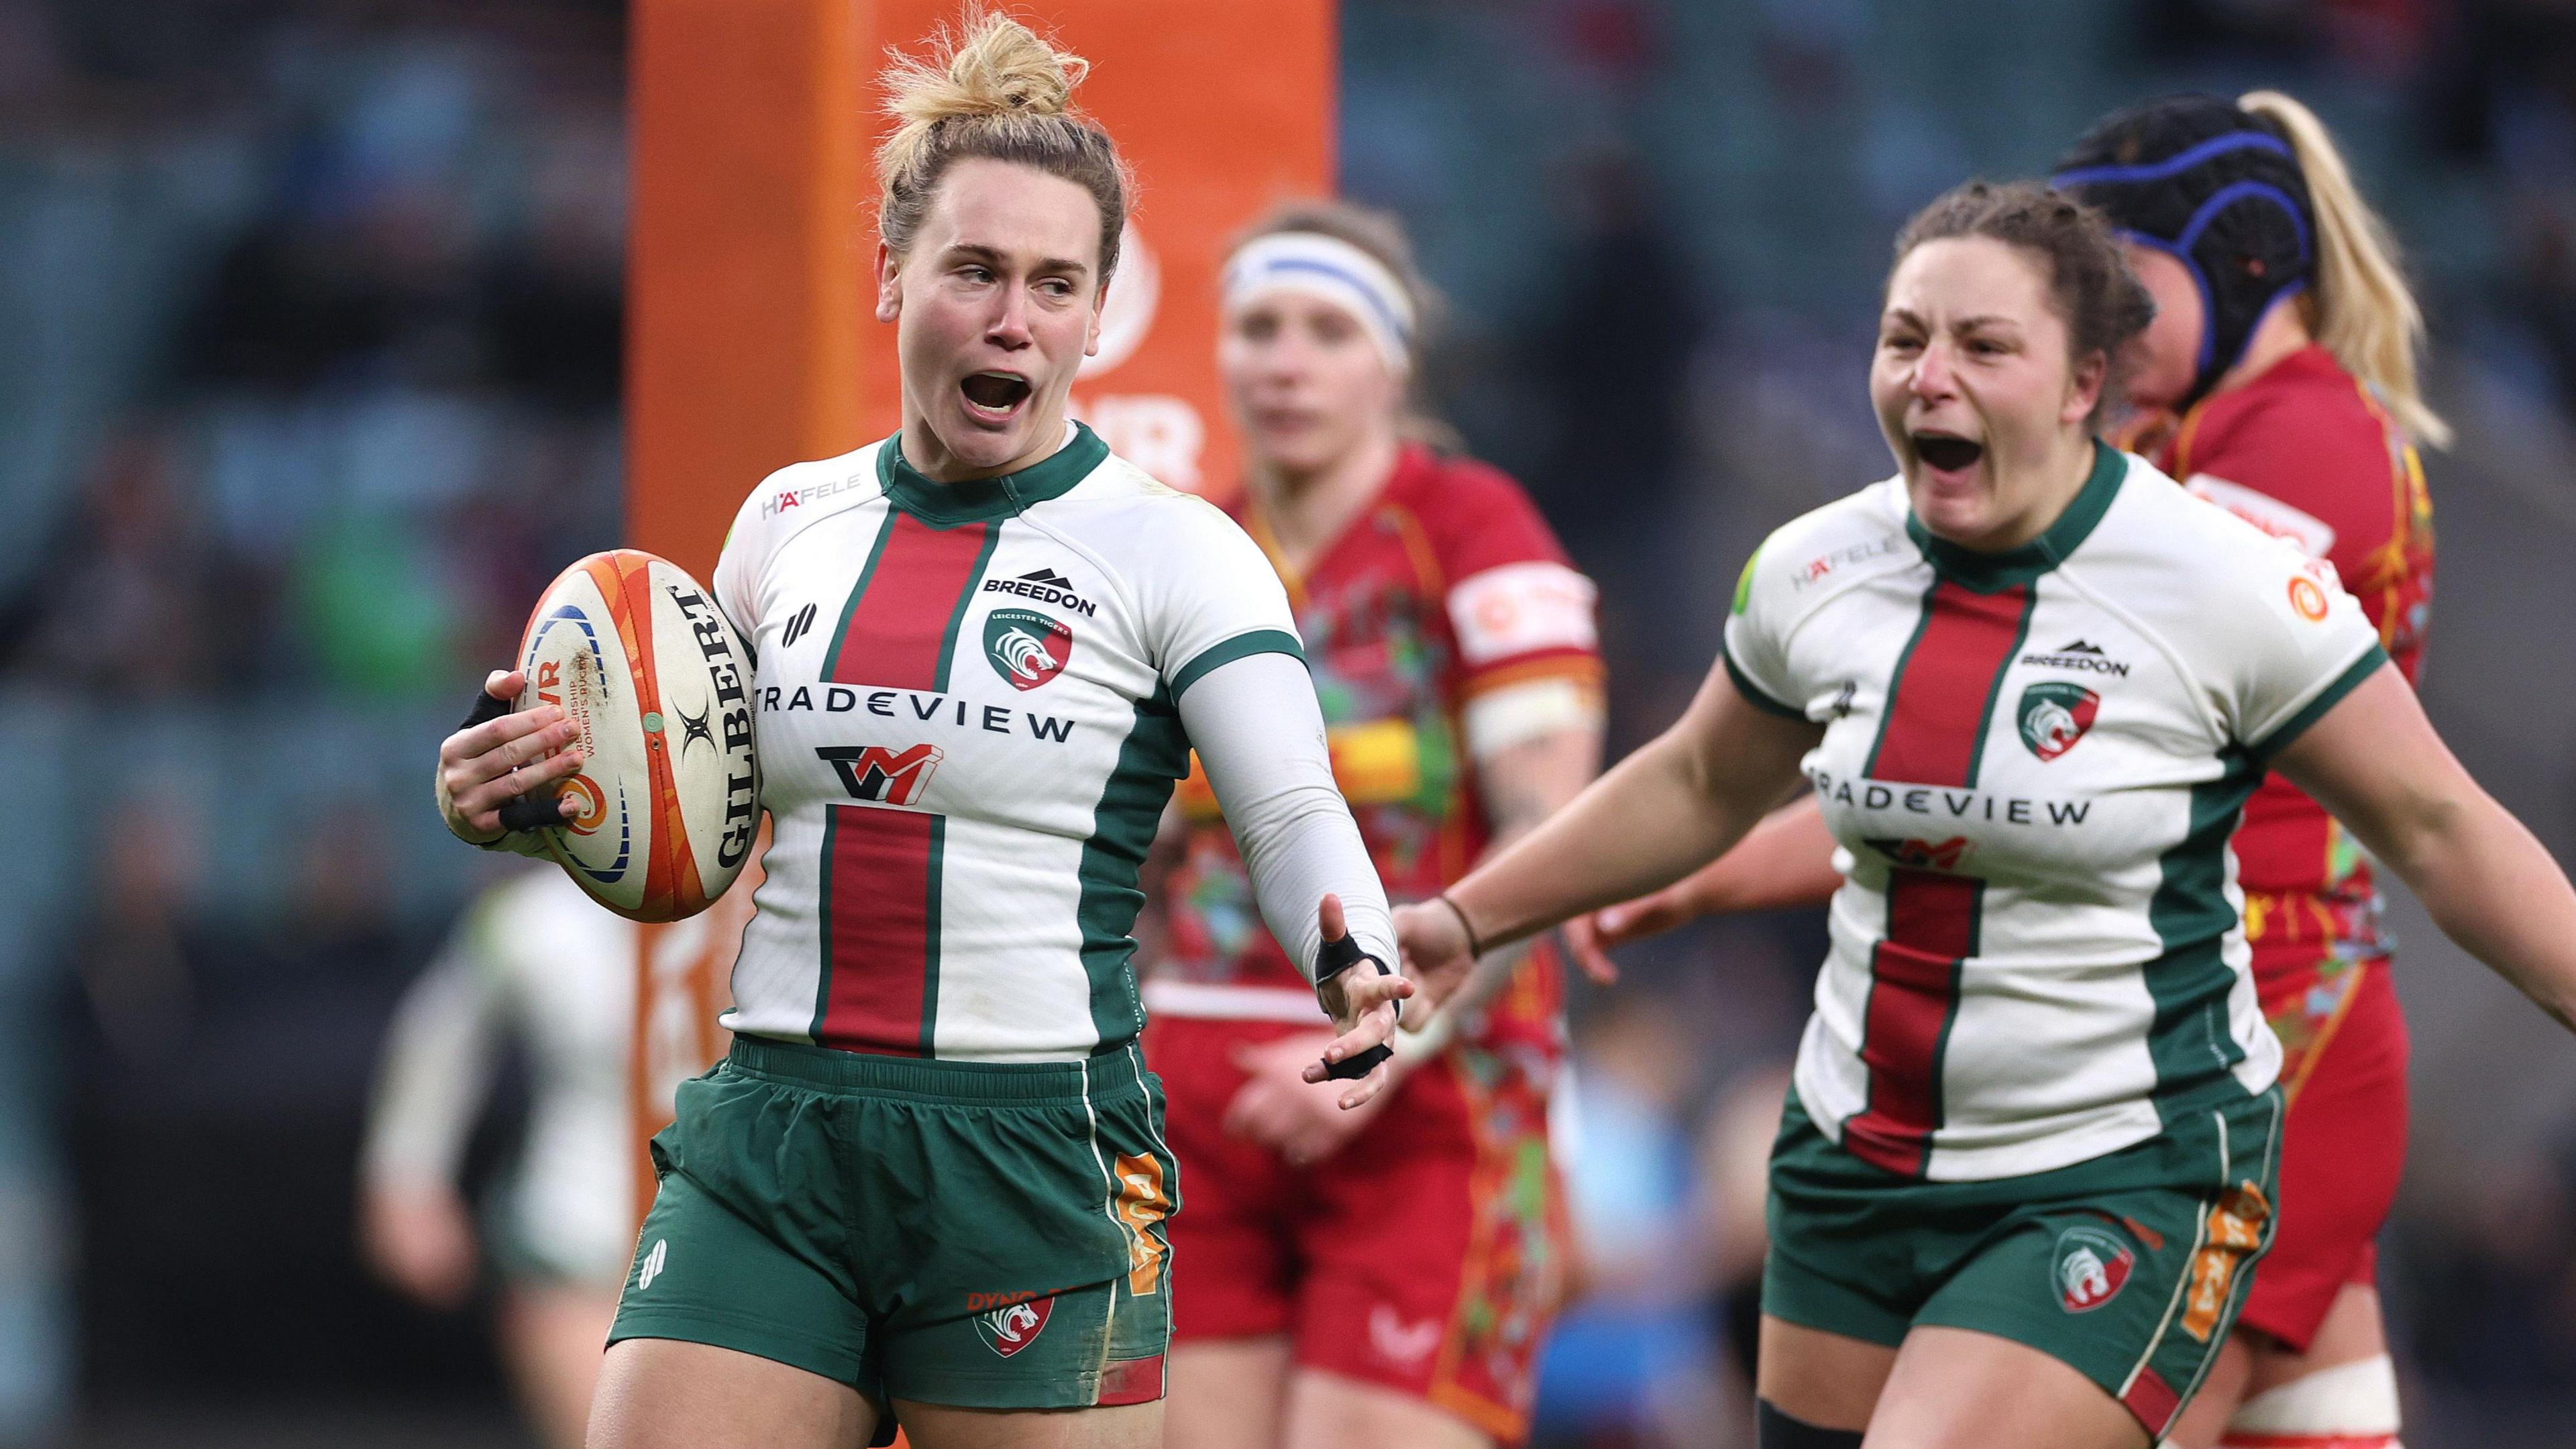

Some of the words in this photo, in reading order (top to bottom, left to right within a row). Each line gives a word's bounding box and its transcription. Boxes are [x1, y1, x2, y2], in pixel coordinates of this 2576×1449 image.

[762, 474, 861, 521] HÄFELE
[983, 580, 1097, 617] BREEDON
[992, 614, 1036, 623] LEICESTER
[1039, 618, 1069, 635] TIGERS
[580, 698, 596, 758] WOMEN'S
[666, 585, 754, 868] GILBERT
